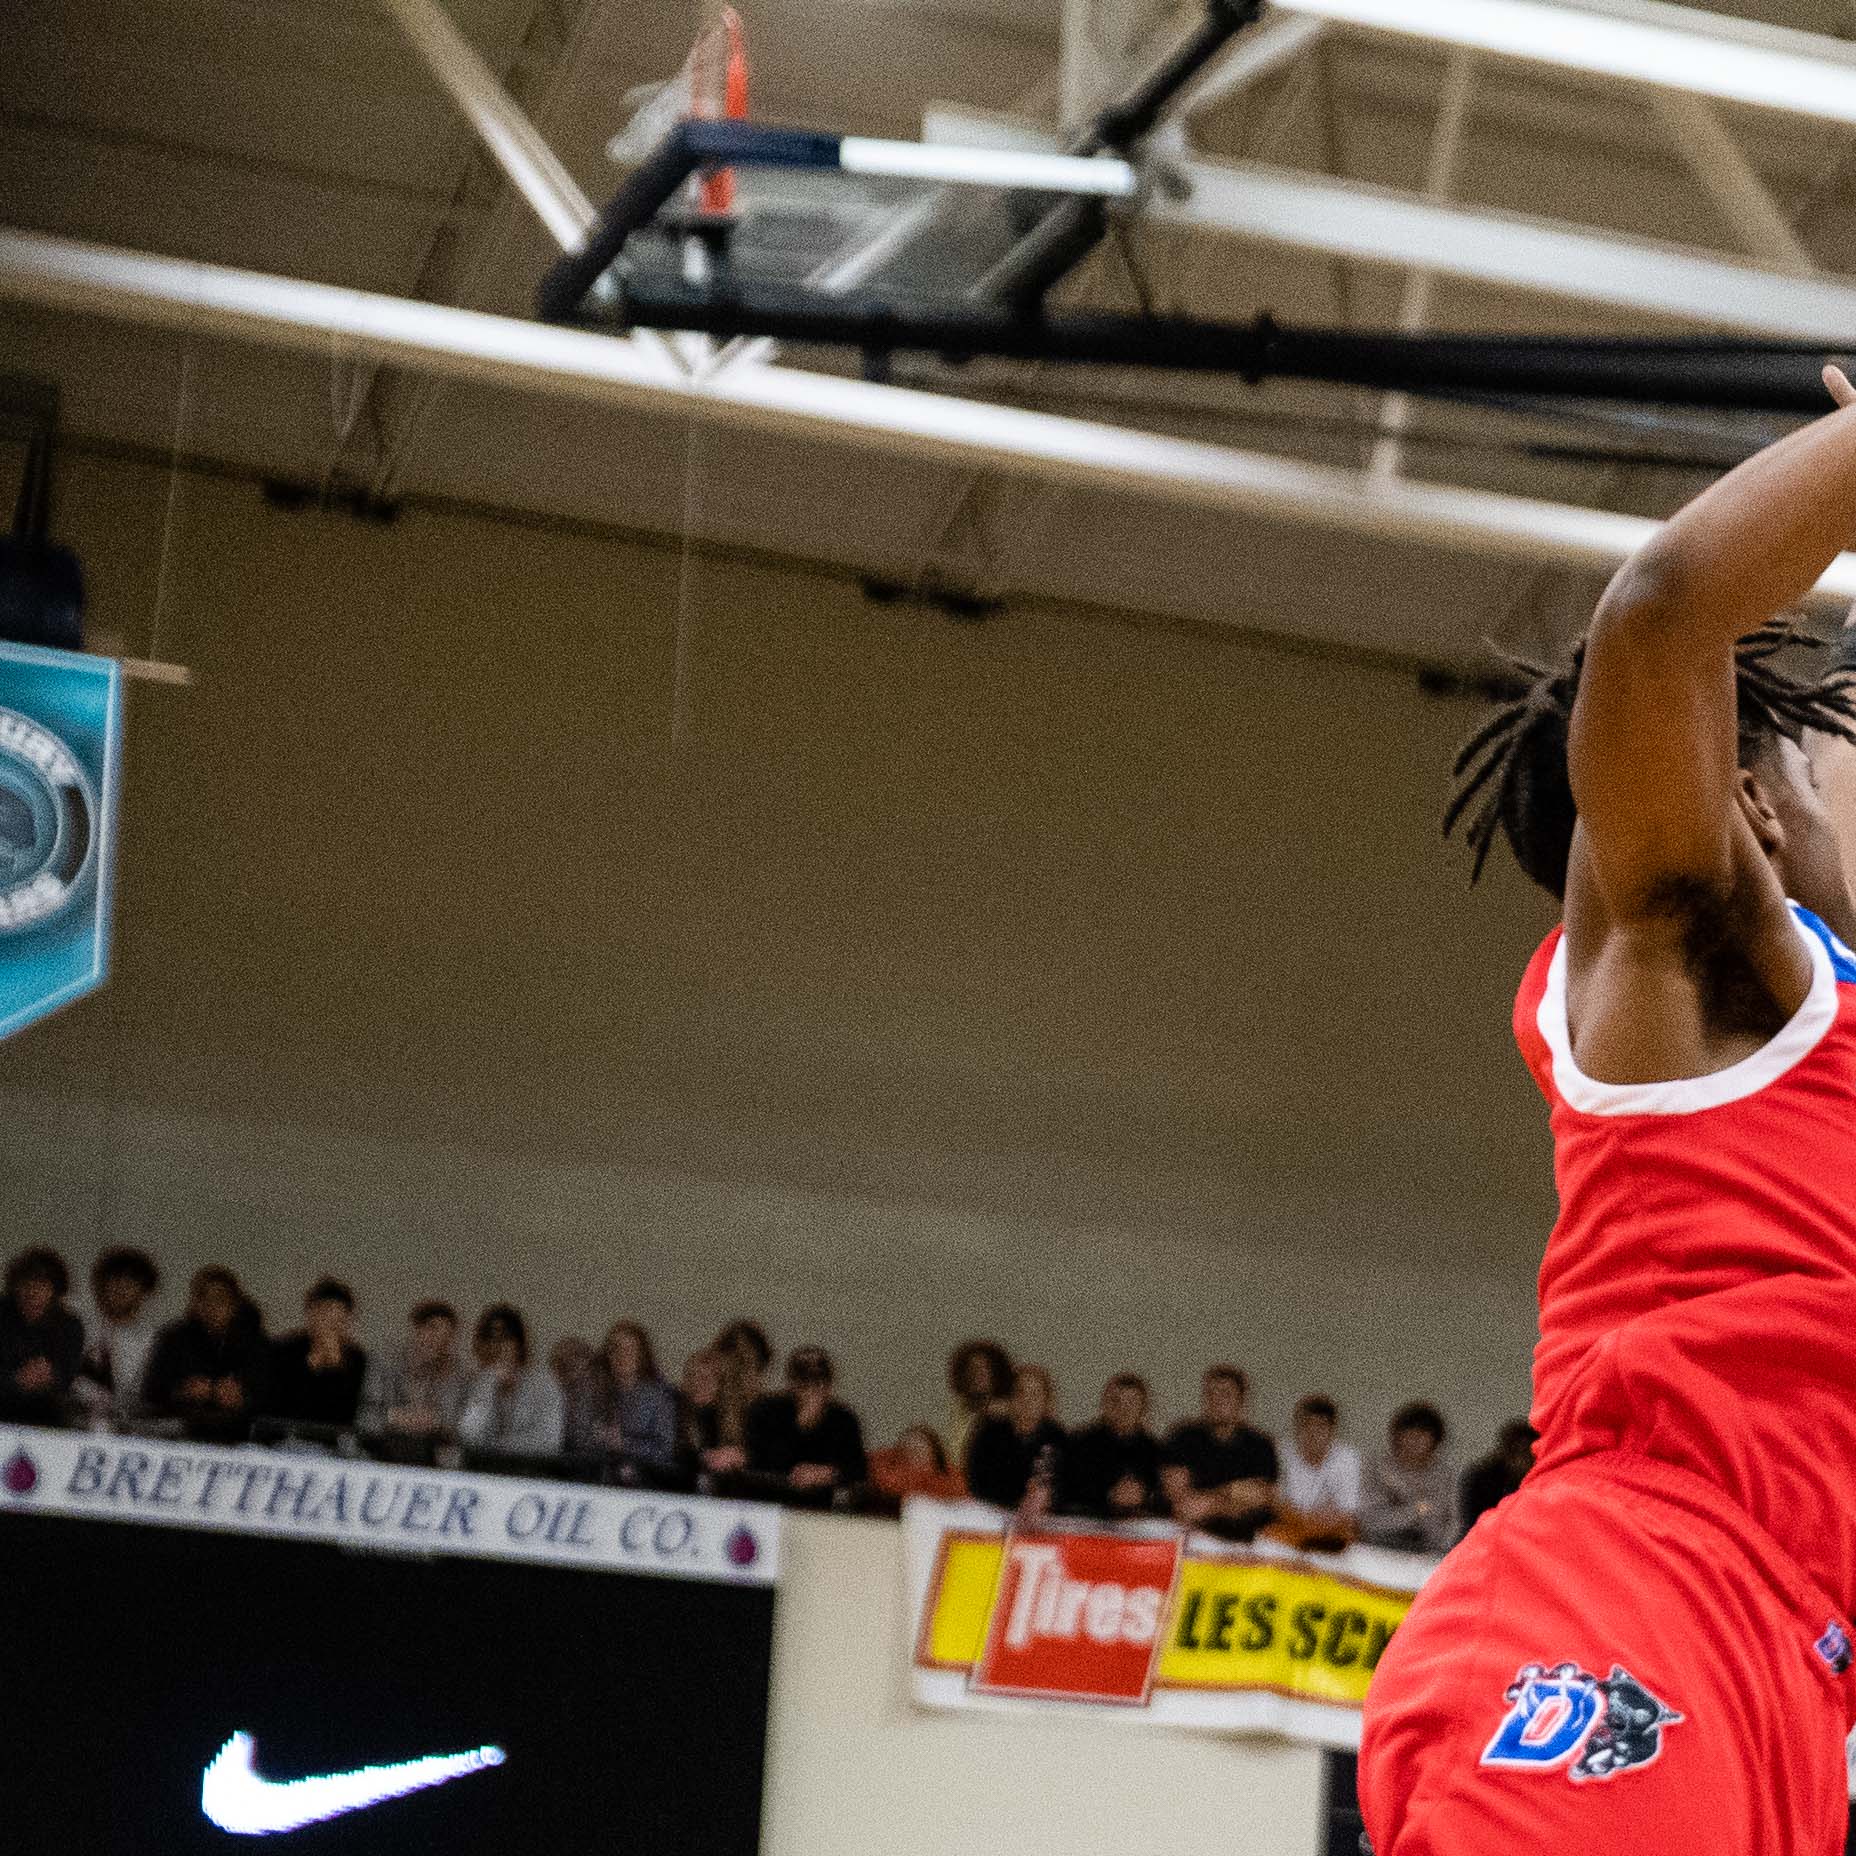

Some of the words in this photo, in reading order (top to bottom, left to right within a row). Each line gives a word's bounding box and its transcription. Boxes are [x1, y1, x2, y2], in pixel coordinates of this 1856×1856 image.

[66, 1445, 479, 1536] BRETTHAUER
[505, 1494, 593, 1547] OIL
[618, 1505, 701, 1557] CO.
[1005, 1543, 1163, 1652] Tires
[1176, 1588, 1277, 1653] LES
